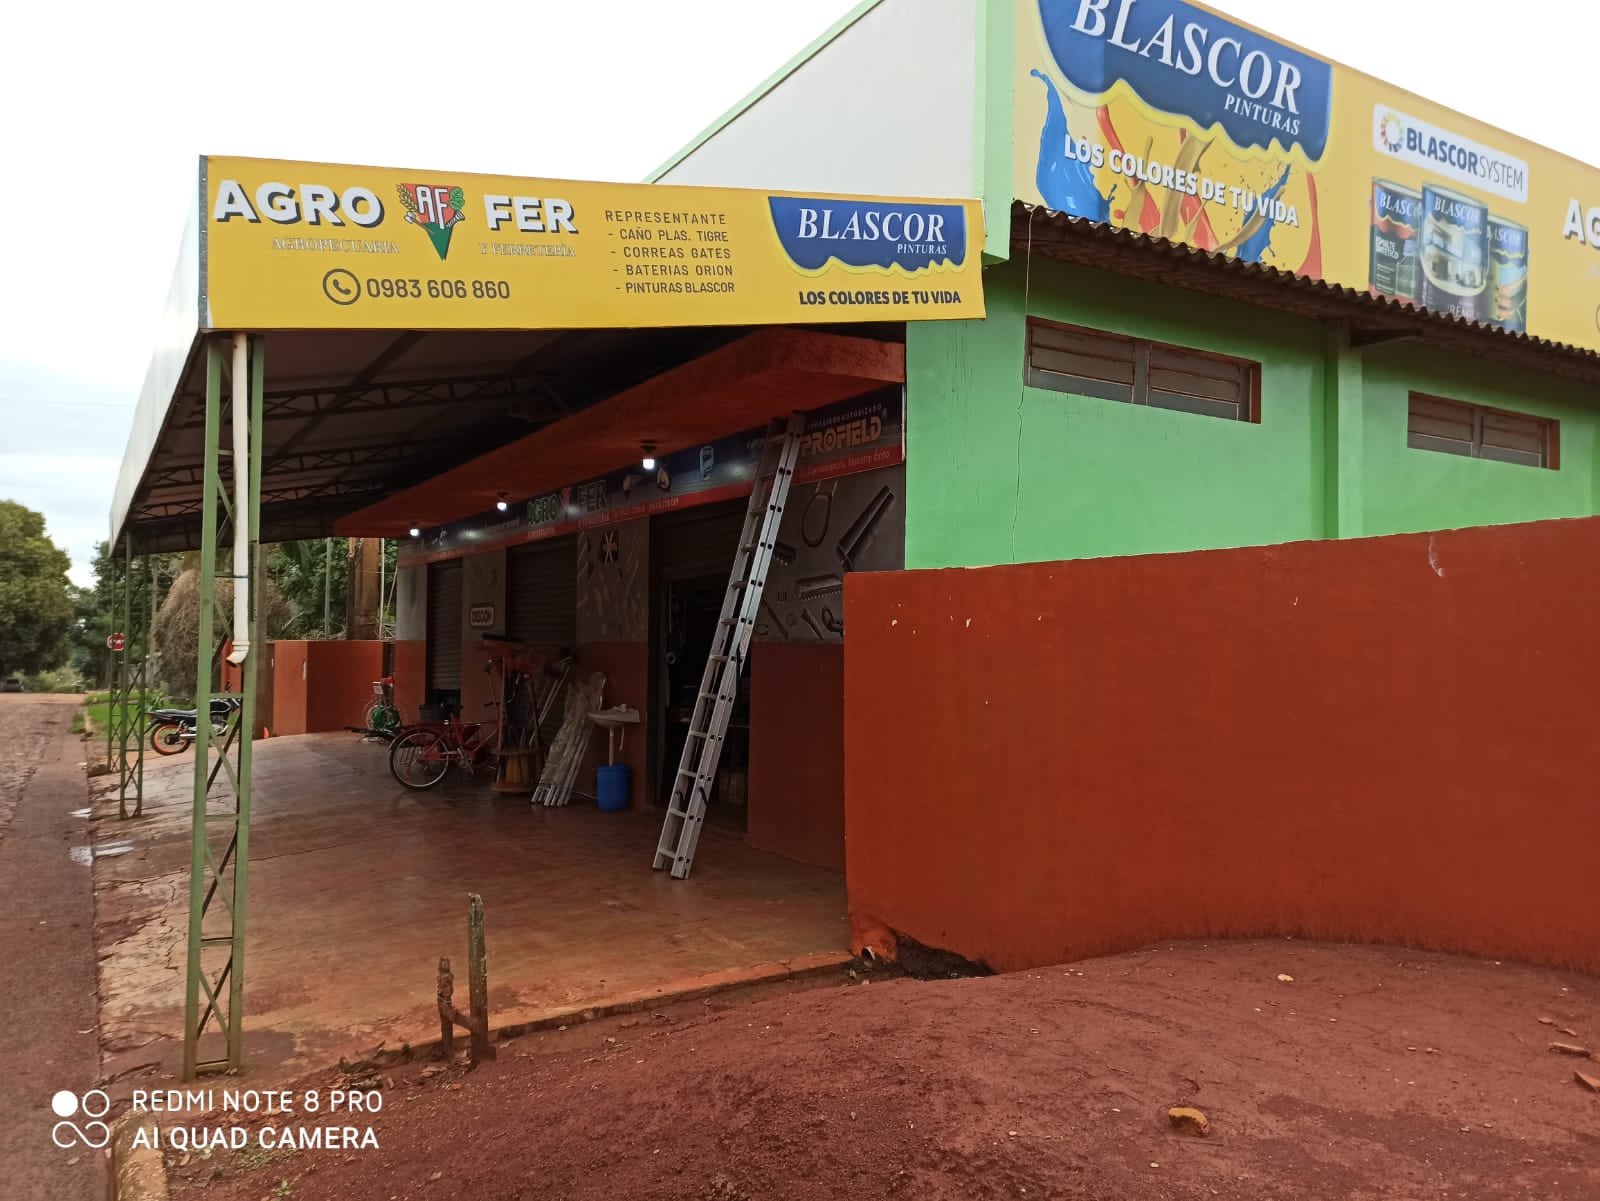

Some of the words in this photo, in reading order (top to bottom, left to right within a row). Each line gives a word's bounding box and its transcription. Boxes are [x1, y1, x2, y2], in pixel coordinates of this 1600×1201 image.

[1070, 0, 1302, 115] BLASCOR
[1224, 94, 1301, 136] PINTURAS
[1064, 133, 1105, 169] LOS
[1108, 149, 1198, 197] COLORES
[1202, 179, 1227, 206] DE
[1229, 186, 1252, 213] TU
[1255, 198, 1300, 228] VIDA
[213, 178, 385, 228] AGRO
[483, 194, 579, 235] FER
[1380, 191, 1416, 217] BLASC
[605, 210, 727, 225] REPRESENTANTE
[797, 208, 946, 244] BLASCOR
[619, 226, 652, 241] CAÑO
[658, 229, 692, 242] PLAS.
[696, 229, 729, 243] TIGRE
[272, 237, 400, 255] AGROPECUARIA
[623, 246, 686, 259] CORREAS
[691, 247, 731, 260] GATES
[897, 243, 948, 255] PINTURAS
[626, 264, 689, 277] BATERIAS
[695, 264, 733, 277] ORION
[366, 278, 422, 299] 0983
[427, 279, 468, 299] 606
[472, 280, 511, 300] 860
[625, 281, 683, 294] PINTURAS
[685, 281, 735, 294] BLASCOR
[799, 290, 827, 306] LOS
[828, 290, 890, 306] COLORES
[892, 290, 910, 305] DE
[911, 290, 930, 305] TU
[931, 290, 962, 305] VIDA
[800, 415, 882, 456] PROFIELD
